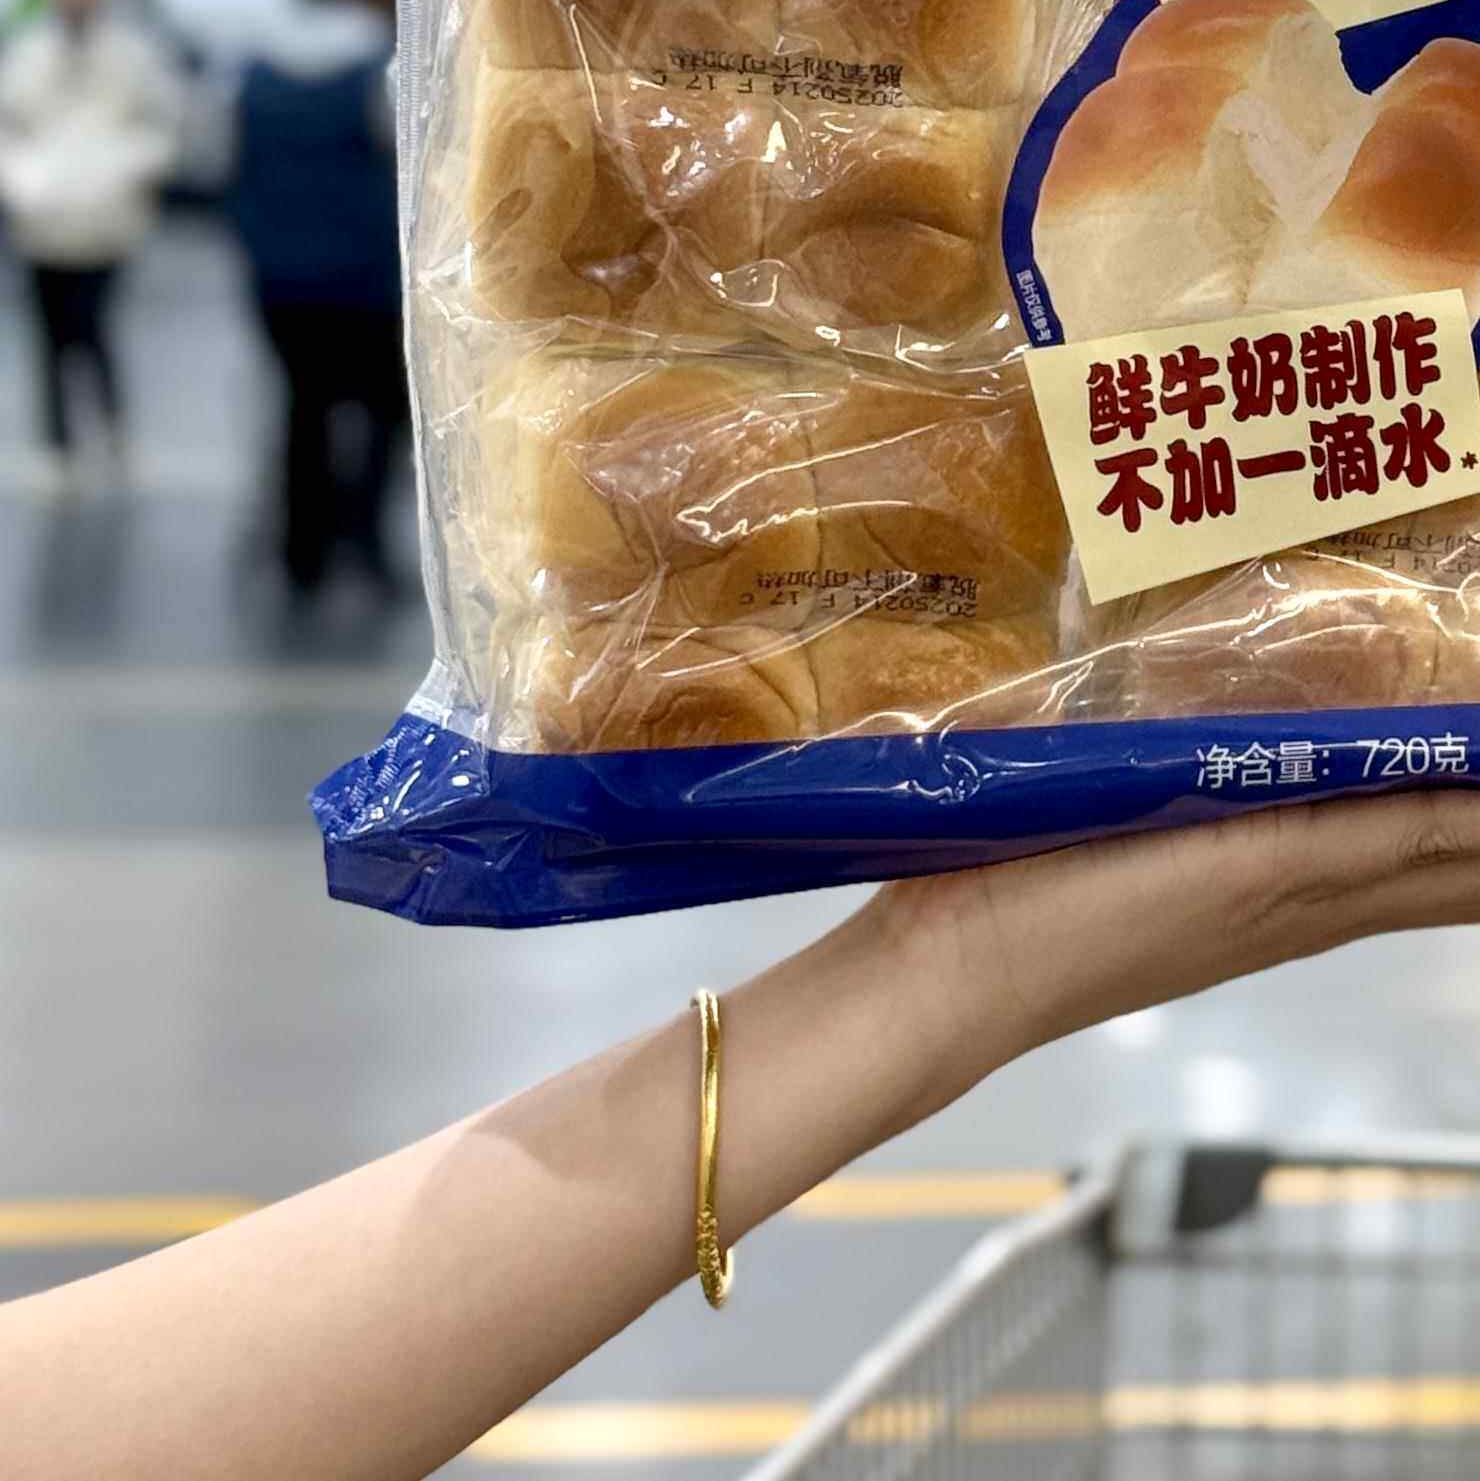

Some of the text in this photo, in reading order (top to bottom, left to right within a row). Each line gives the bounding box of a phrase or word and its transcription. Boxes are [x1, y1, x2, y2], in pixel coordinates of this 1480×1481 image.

[1016, 270, 1052, 342] 图片仅供参考
[1086, 311, 1442, 446] 鲜牛奶制作
